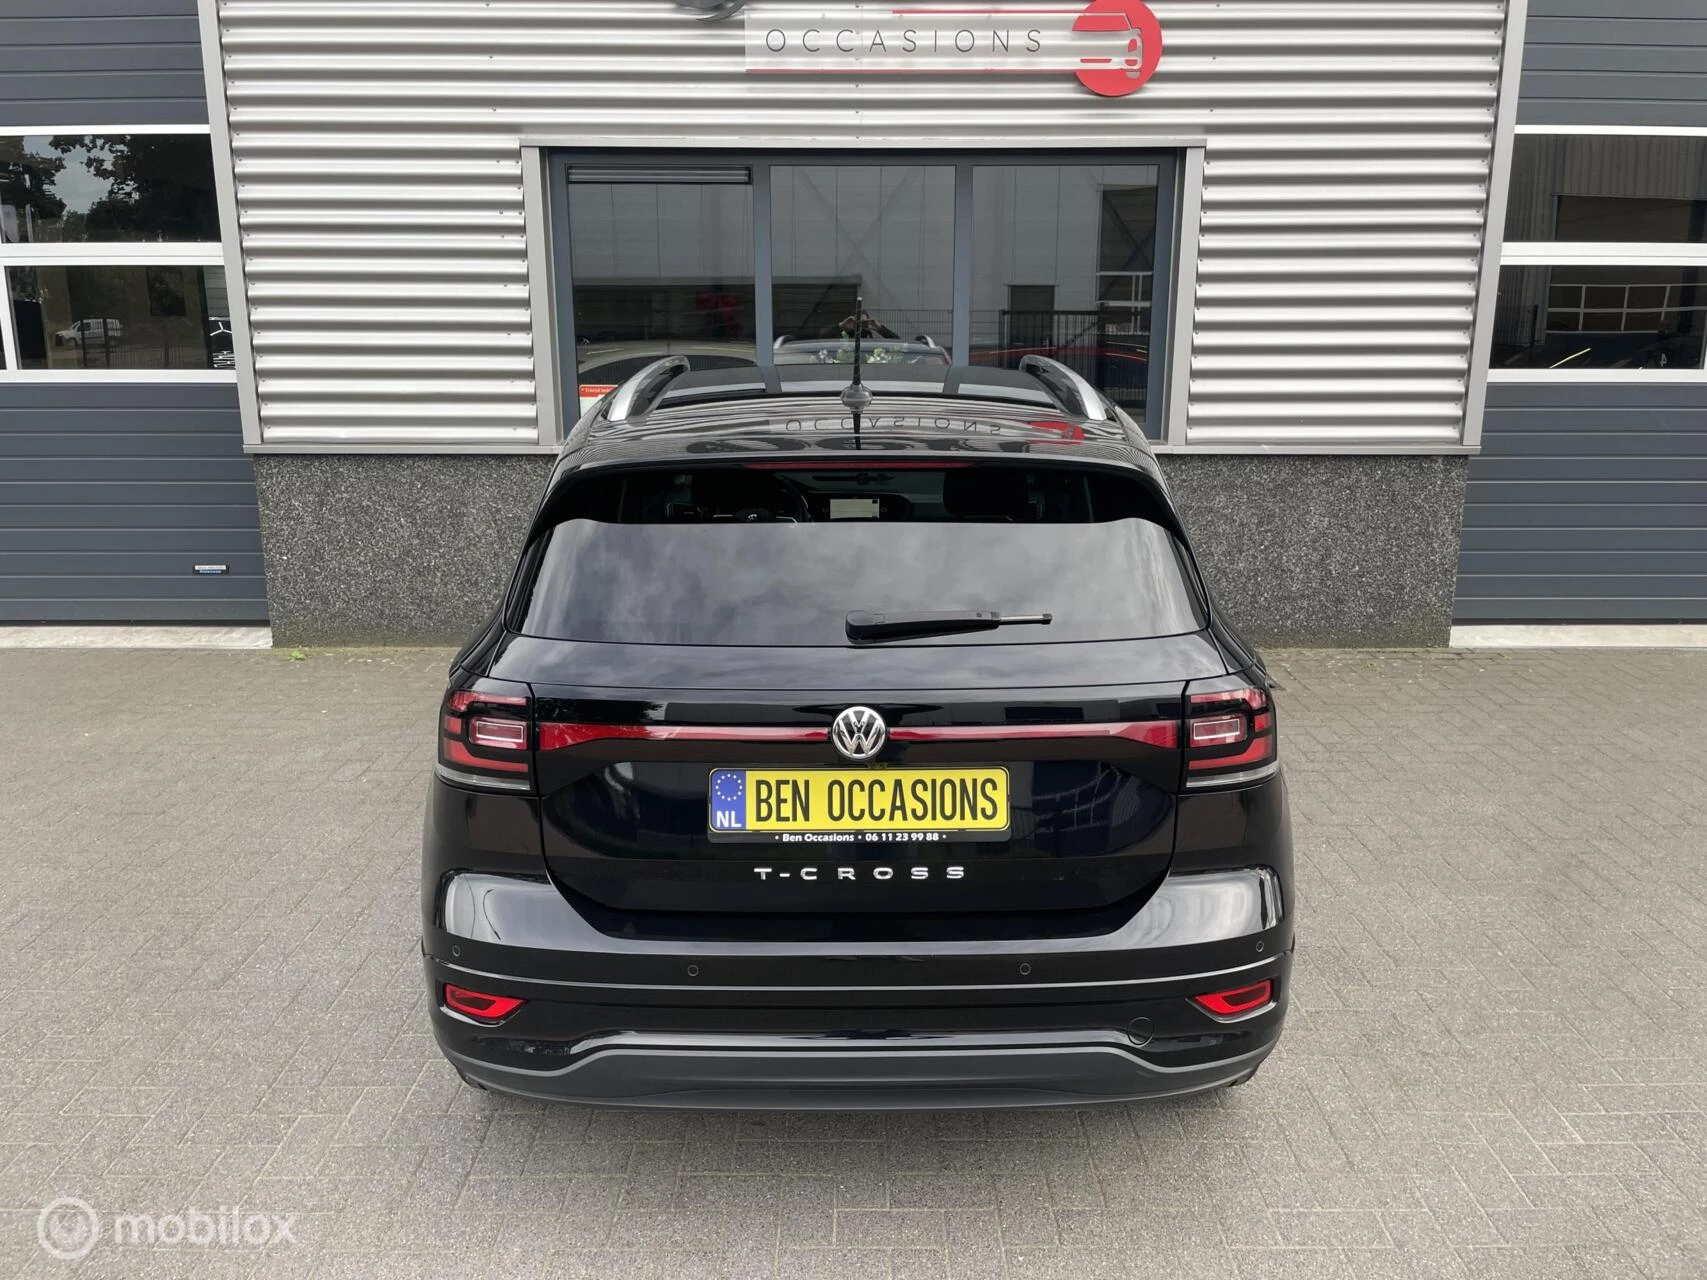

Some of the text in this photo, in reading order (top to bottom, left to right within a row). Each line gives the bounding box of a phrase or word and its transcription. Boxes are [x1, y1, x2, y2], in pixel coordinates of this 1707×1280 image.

[765, 28, 1042, 54] OCCASIONS
[755, 777, 999, 822] BEN OCCASIONS
[716, 810, 742, 828] NL
[782, 833, 939, 842] Ben Occasions 06 11 23 99 88
[753, 866, 965, 880] T-CROSS
